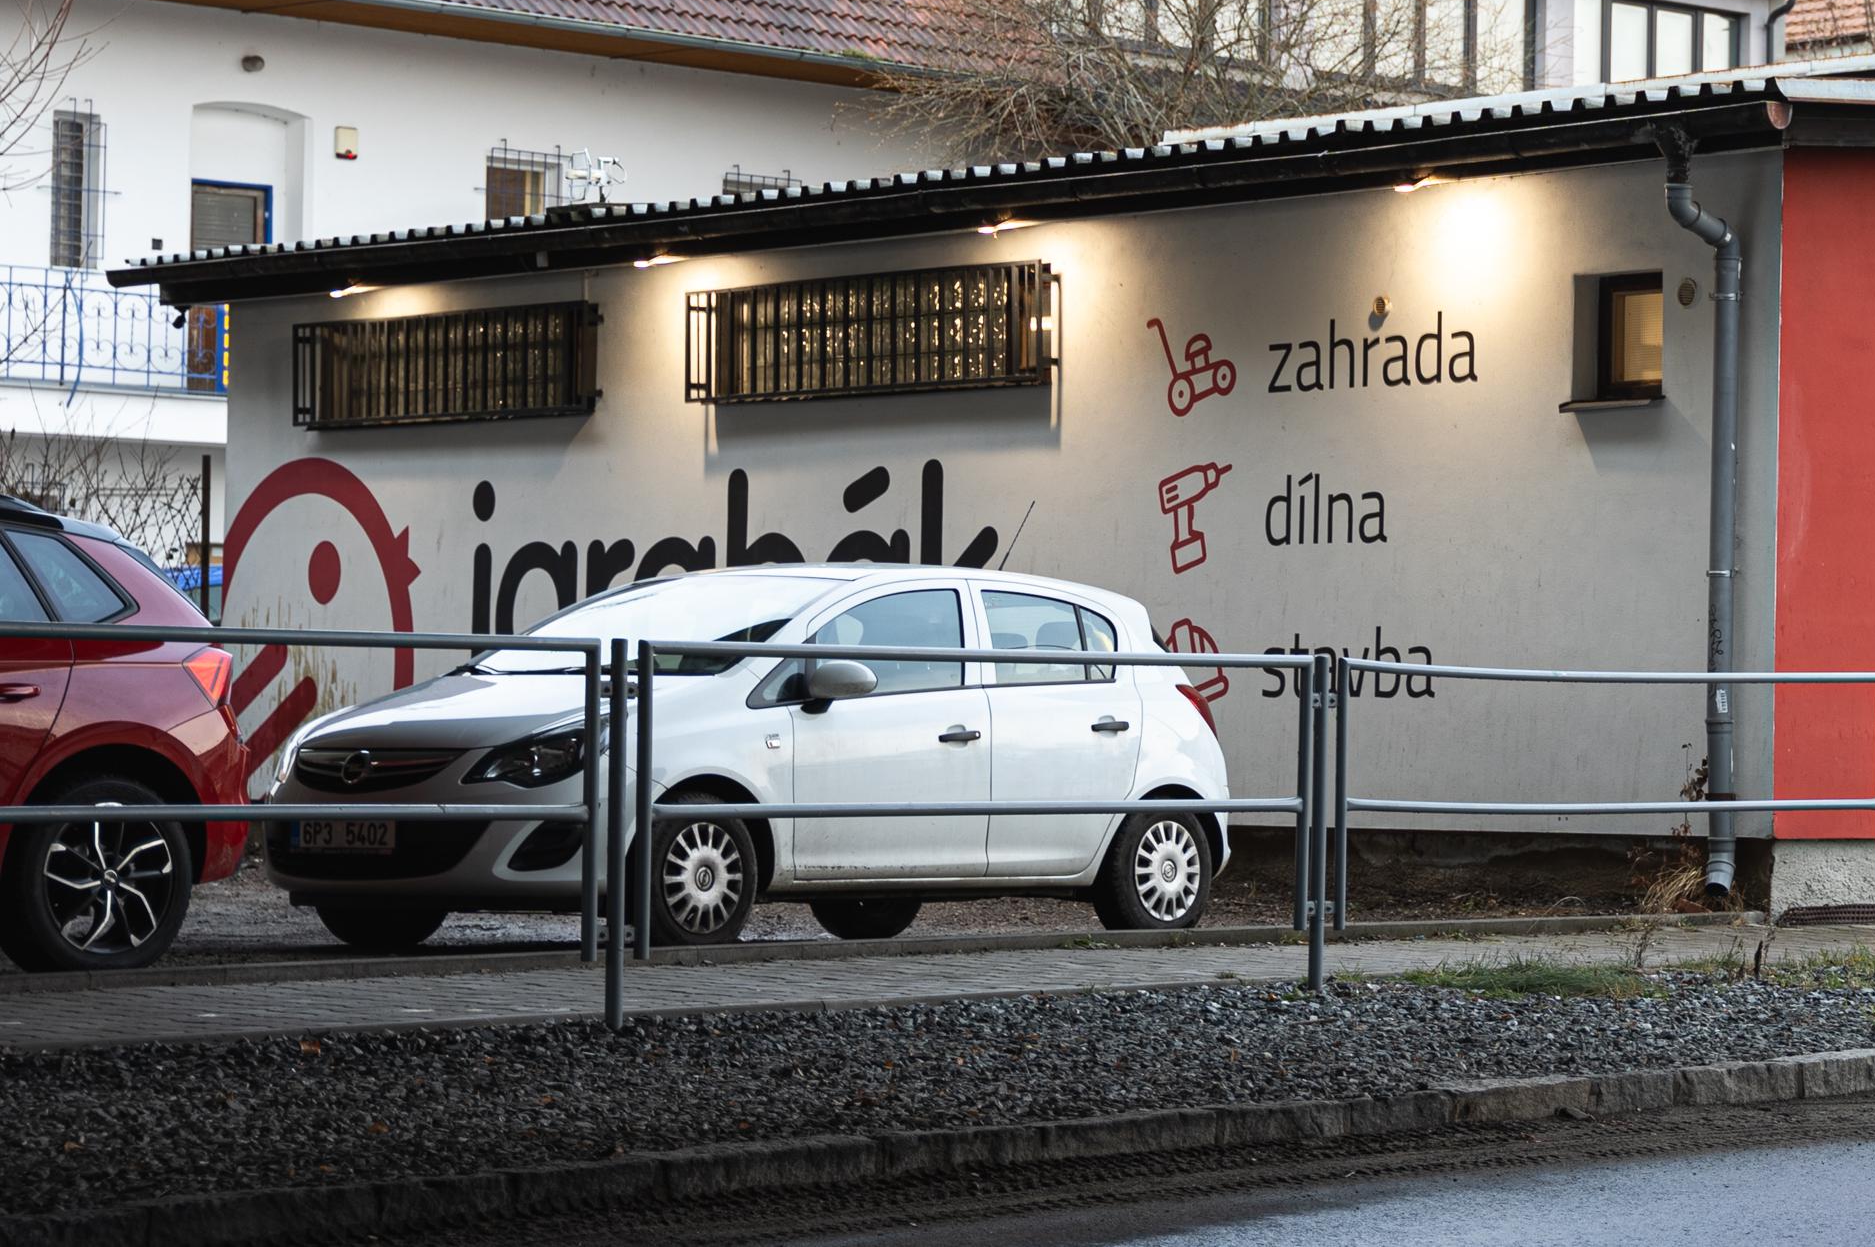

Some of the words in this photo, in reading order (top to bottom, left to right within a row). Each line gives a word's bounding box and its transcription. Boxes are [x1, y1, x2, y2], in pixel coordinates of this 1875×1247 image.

[1268, 311, 1478, 394] zahrada
[1265, 472, 1388, 547] dílna
[302, 822, 333, 846] 6P3
[345, 822, 388, 846] 5402
